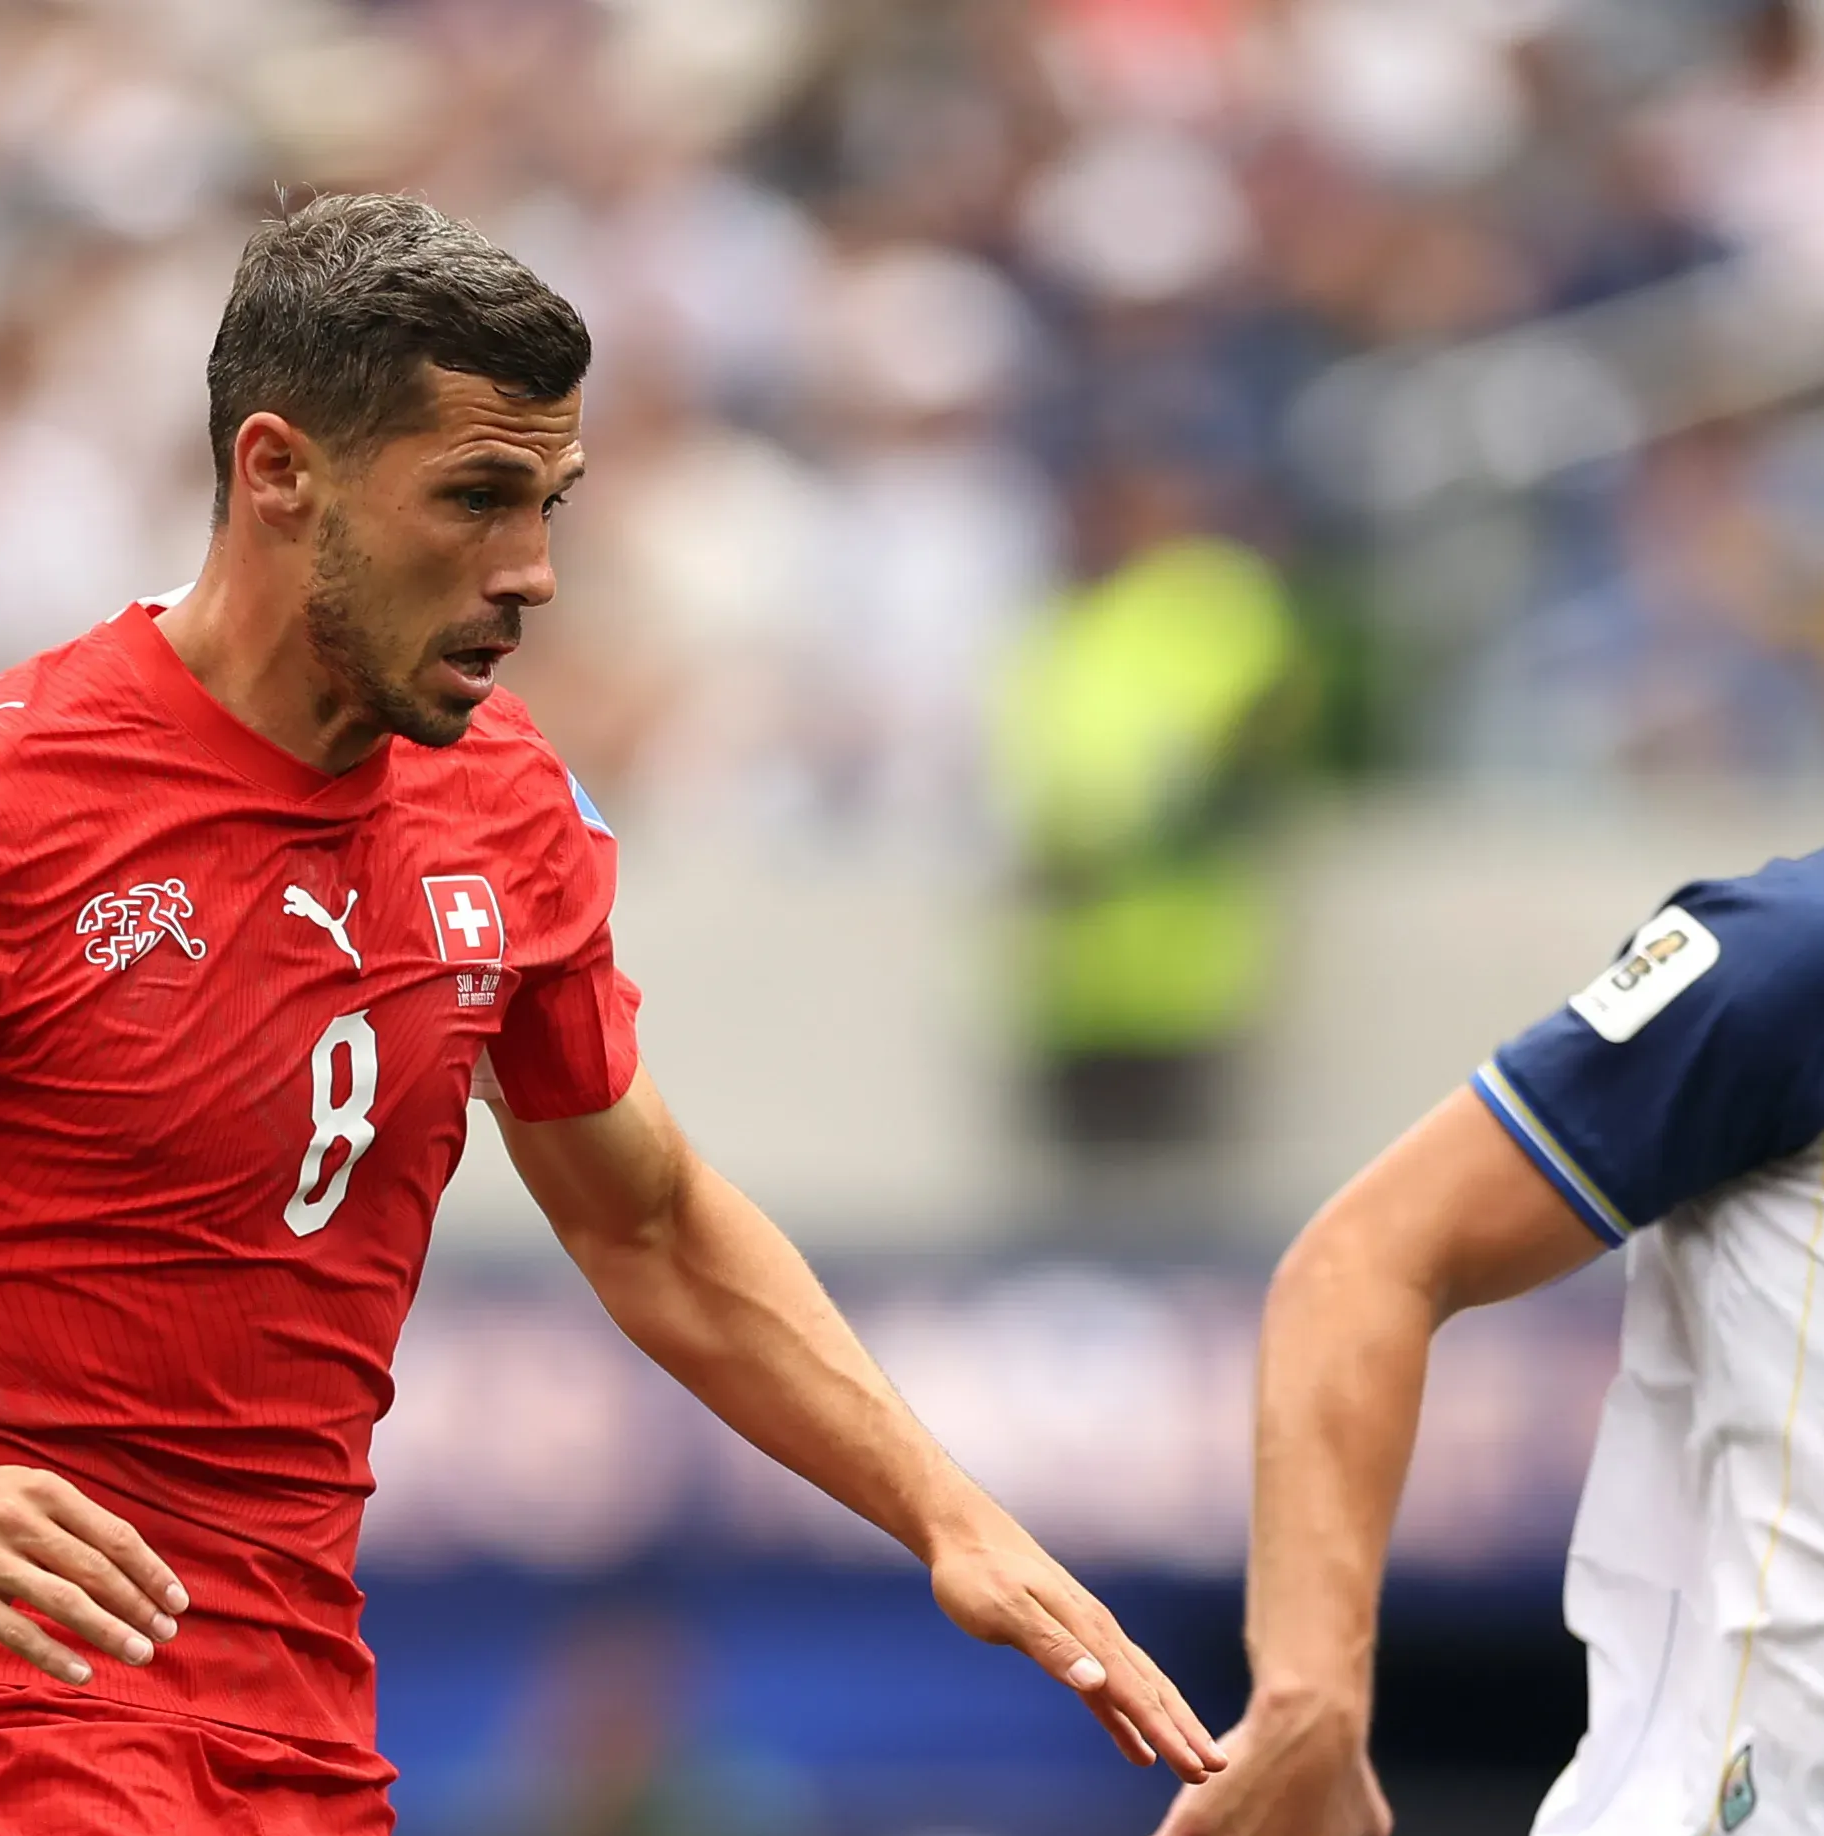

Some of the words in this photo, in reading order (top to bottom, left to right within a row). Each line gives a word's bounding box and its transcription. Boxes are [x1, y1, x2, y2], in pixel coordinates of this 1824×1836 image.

[456, 973, 473, 993] SUI
[480, 973, 501, 992] BIH
[457, 992, 470, 1007] LOS
[470, 992, 496, 1006] ANGELES
[283, 1008, 379, 1238] 8
